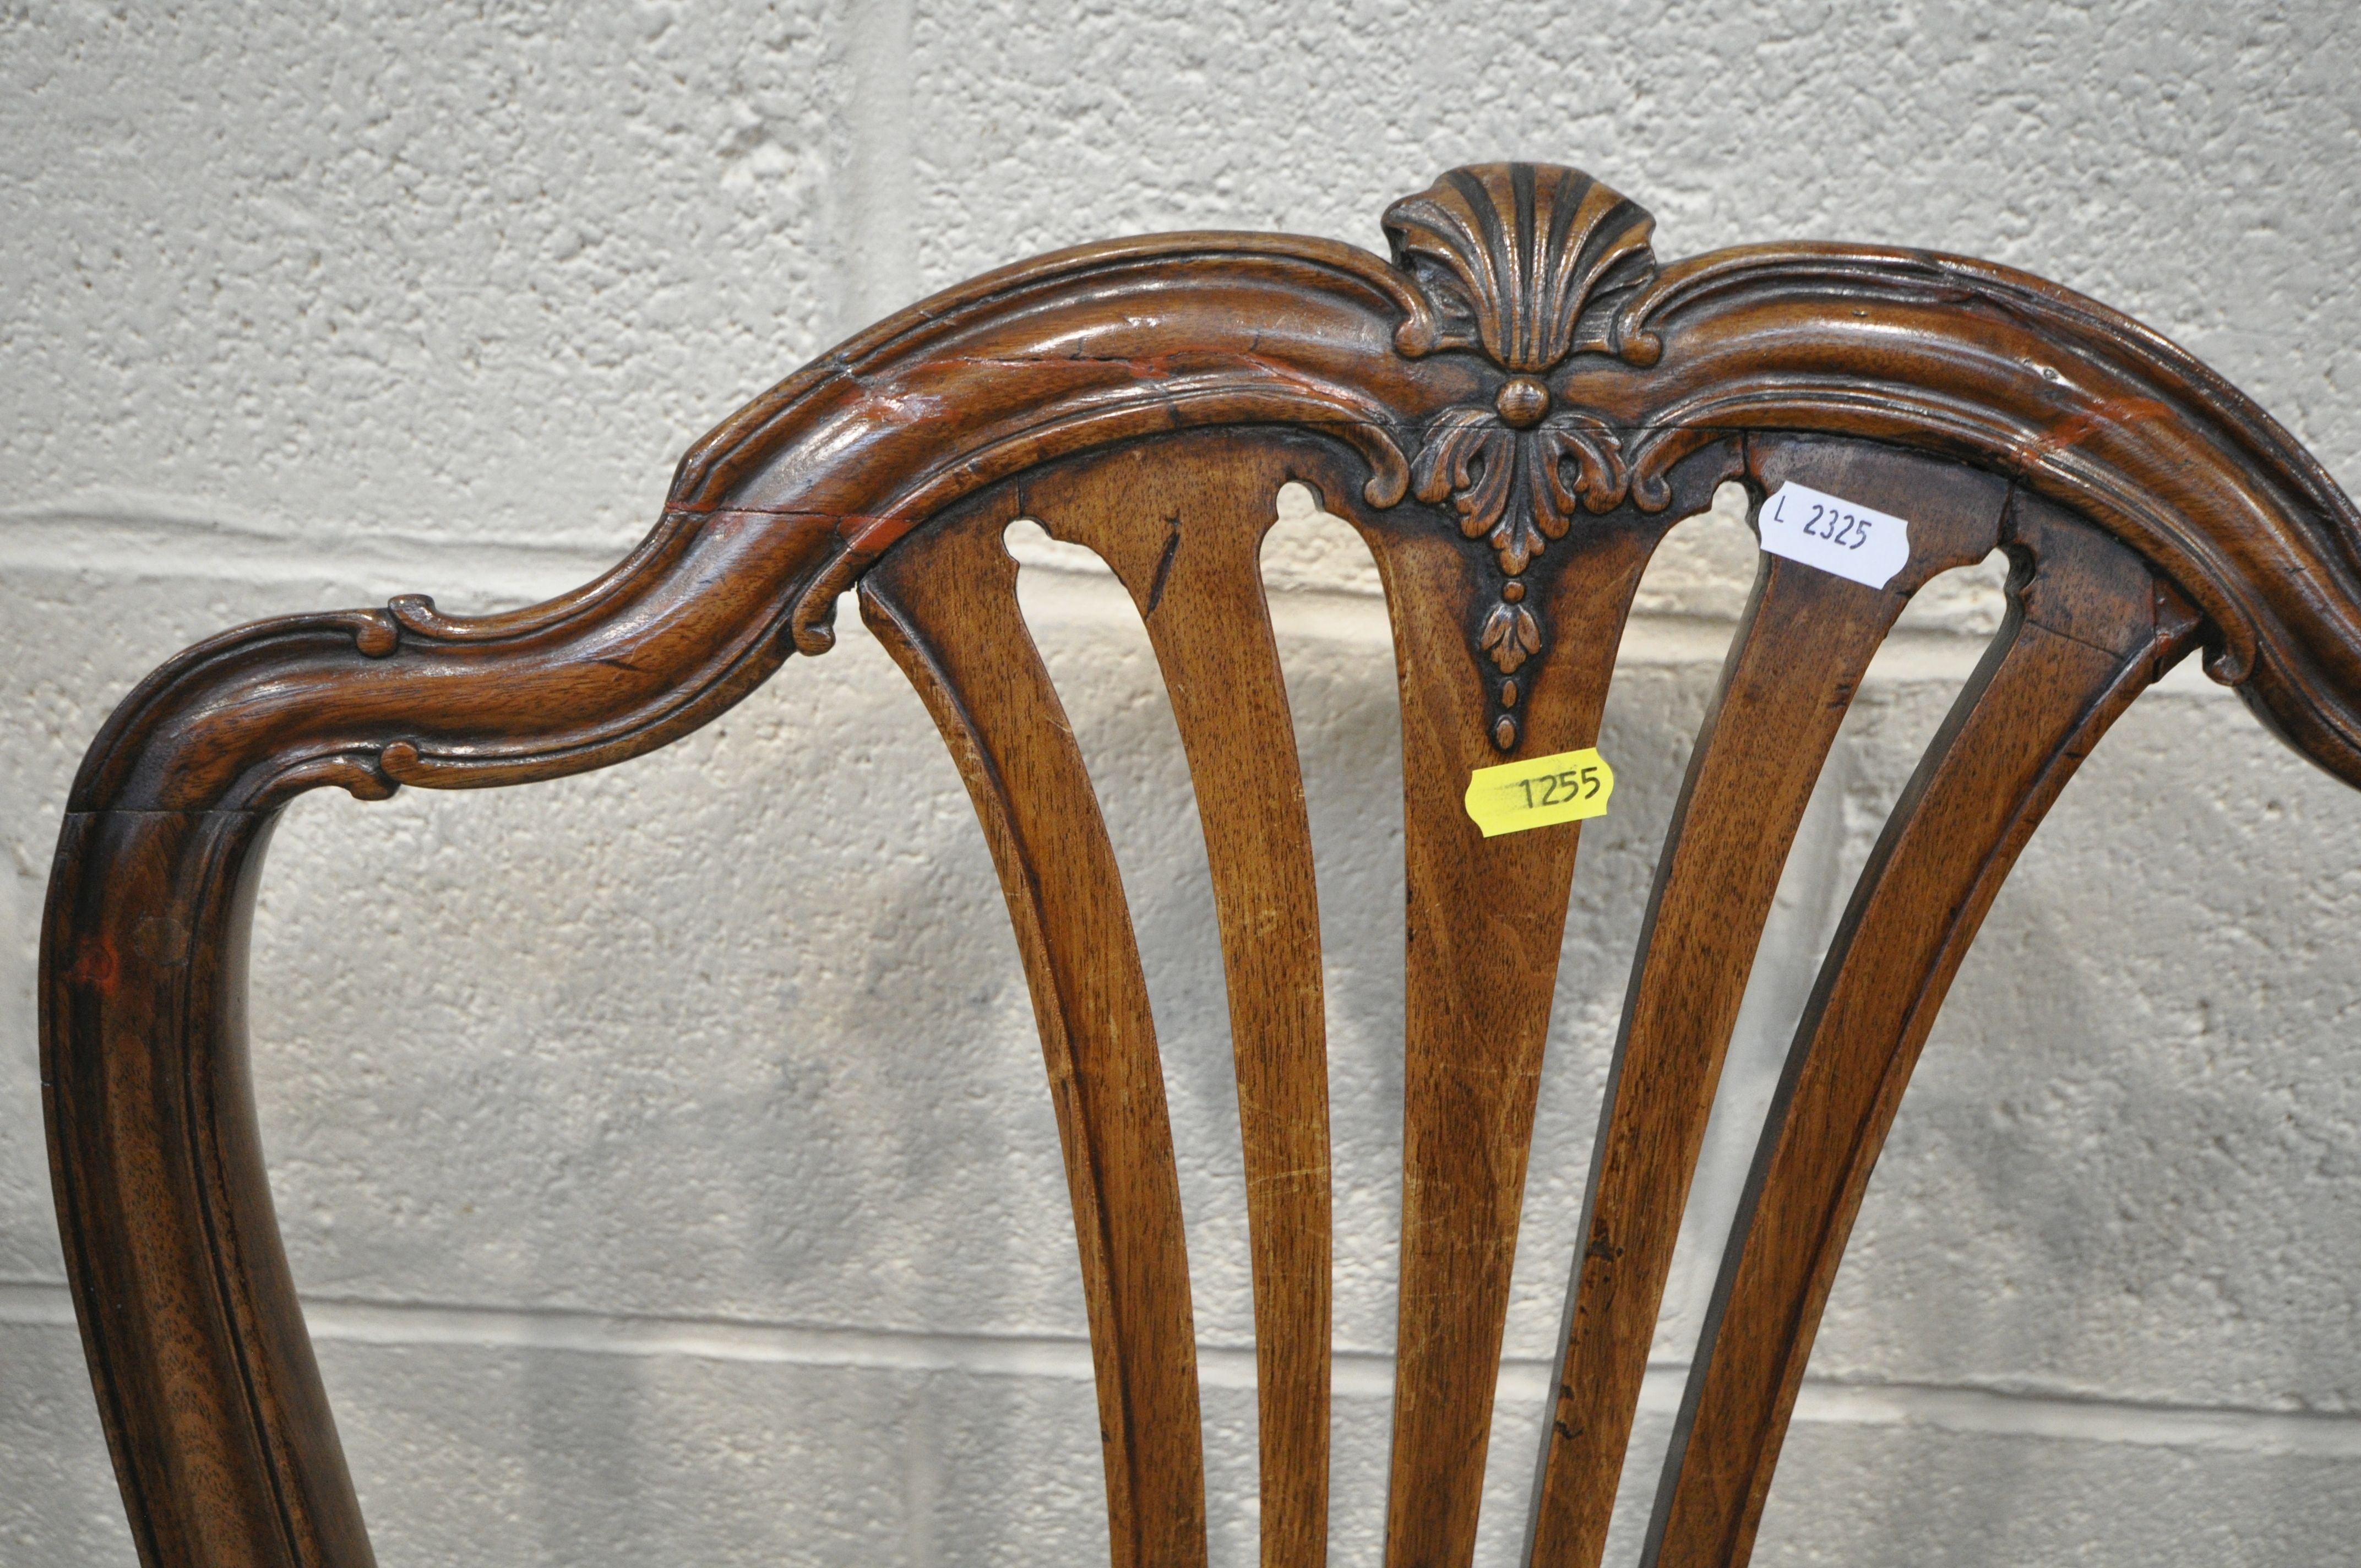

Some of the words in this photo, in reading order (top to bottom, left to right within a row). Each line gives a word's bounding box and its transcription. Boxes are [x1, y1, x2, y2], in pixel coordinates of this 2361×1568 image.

[1774, 495, 1786, 523] L
[1803, 504, 1872, 550] 2325
[1519, 766, 1601, 809] 1255
